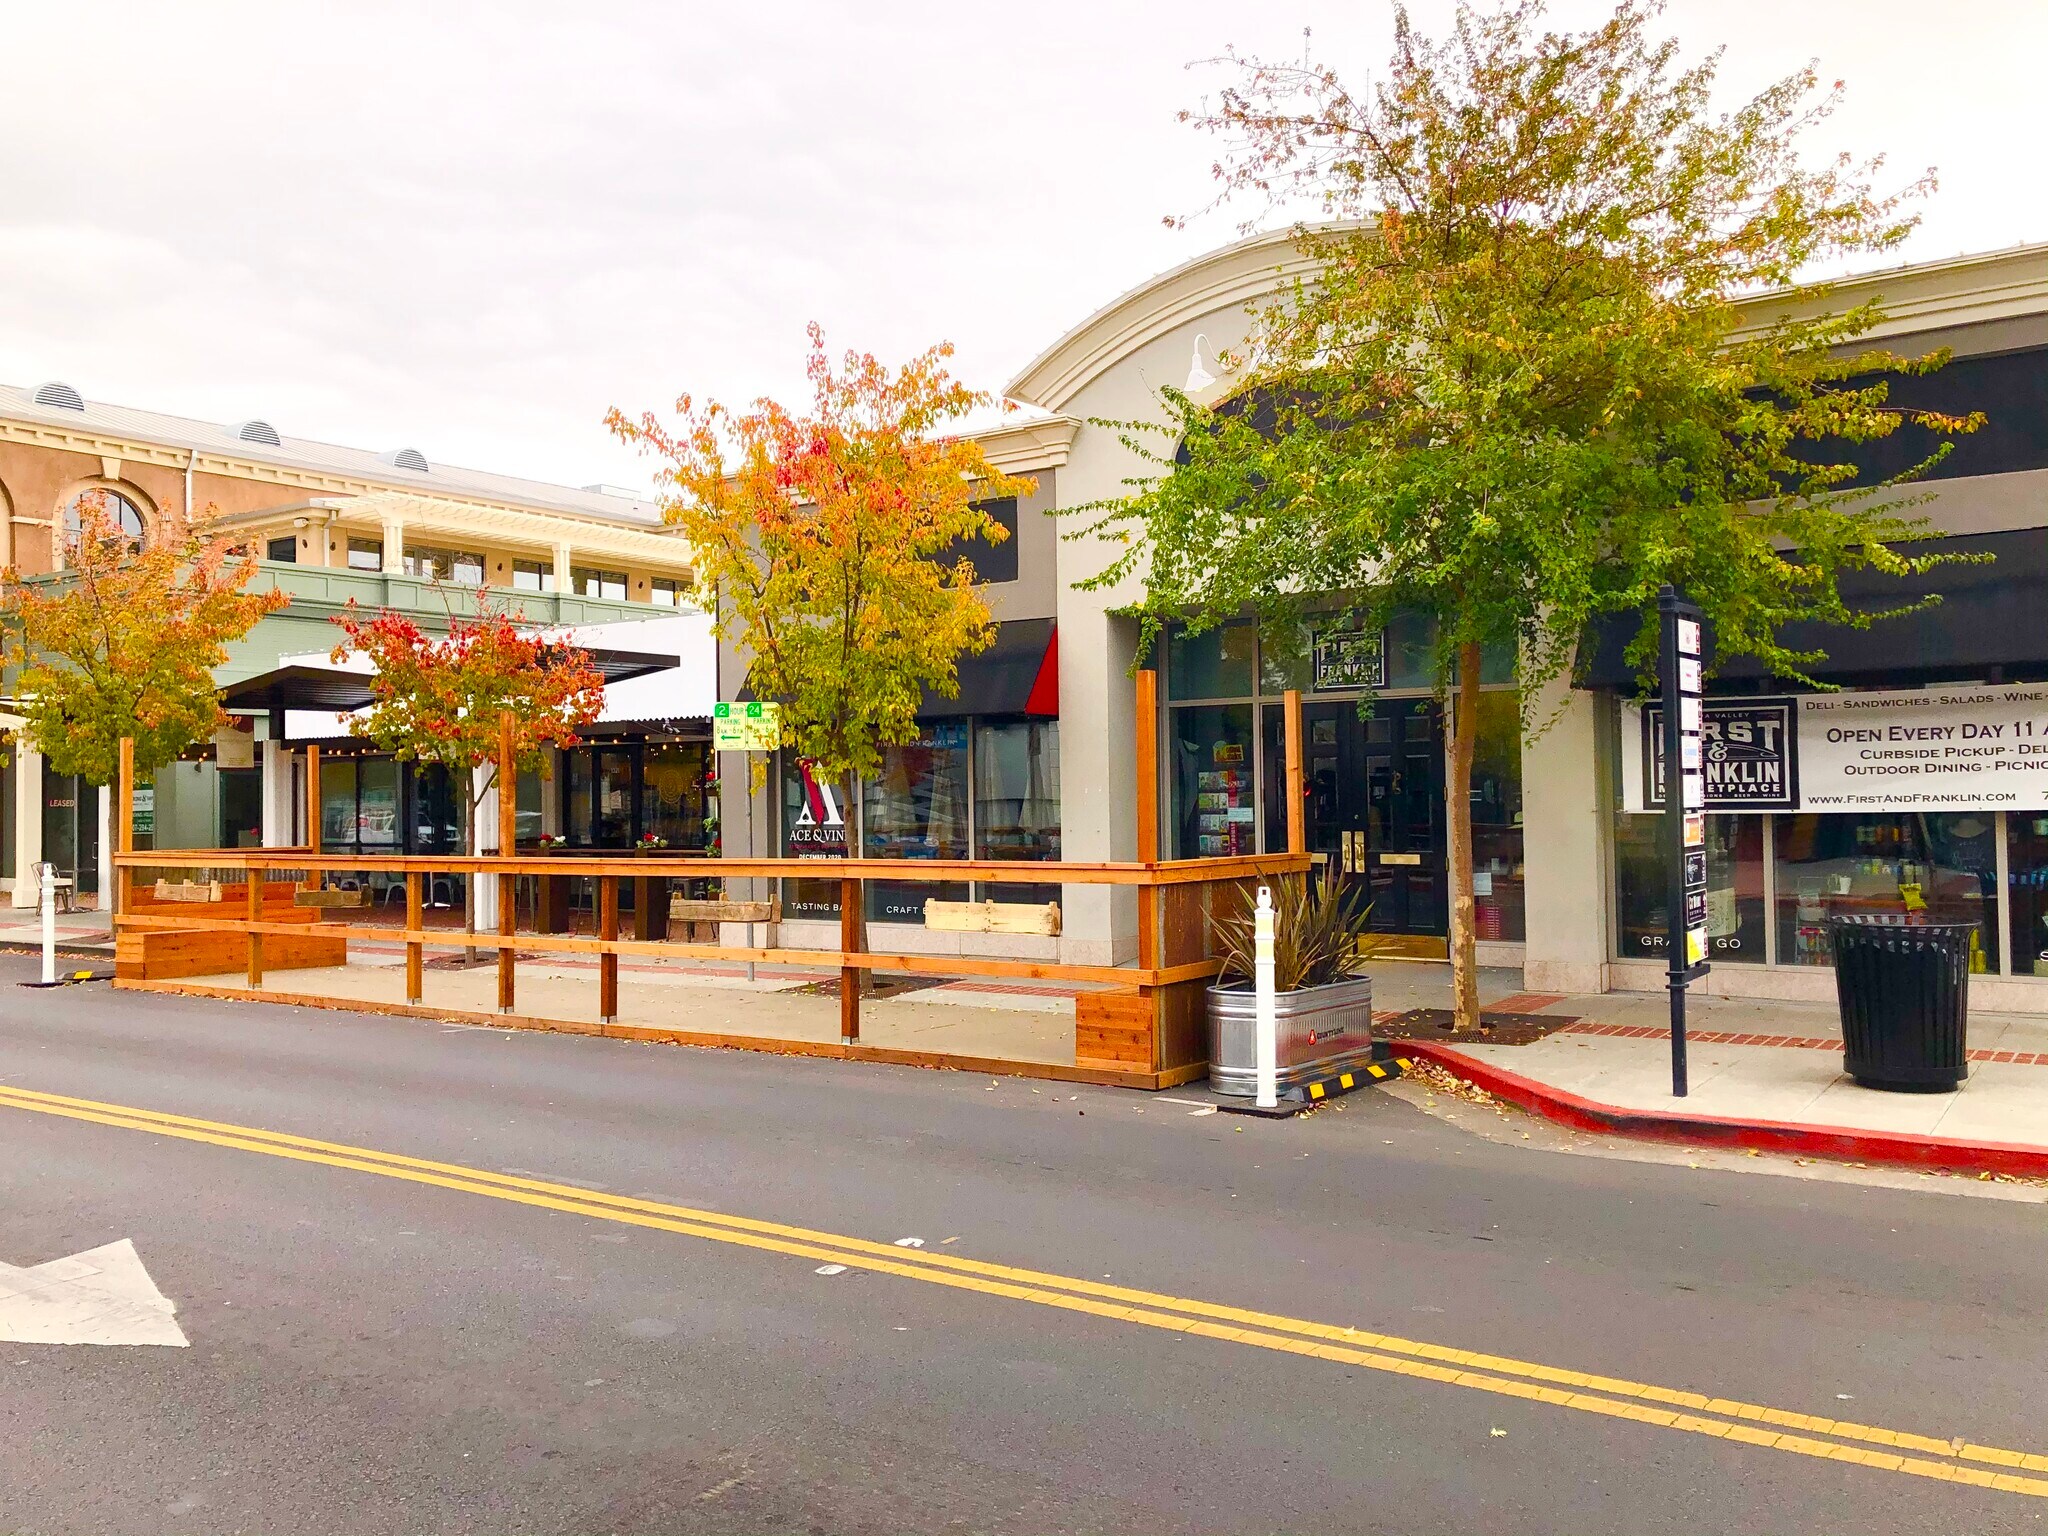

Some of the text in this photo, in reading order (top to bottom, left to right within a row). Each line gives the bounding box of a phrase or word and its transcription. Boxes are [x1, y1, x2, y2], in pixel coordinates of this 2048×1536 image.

[1806, 701, 1834, 710] DELI
[1843, 697, 1930, 709] SANDWICHES
[1940, 695, 1994, 705] SALADS
[2004, 692, 2043, 701] WINE
[718, 705, 726, 716] 2
[749, 705, 760, 715] 24
[1827, 728, 1882, 743] OPEN
[1889, 725, 1956, 741] EVERY
[1962, 723, 2005, 739] DAY
[2013, 721, 2032, 737] 11
[1708, 741, 1728, 761] &
[1860, 749, 1940, 759] CURBSIDE
[1945, 747, 2006, 757] PICKUP
[1844, 764, 1920, 775] OUTDOOR
[1925, 763, 1982, 773] DINING
[1659, 784, 1780, 793] METPLACE
[50, 799, 75, 807] LEASED
[789, 828, 847, 843] ACE & VIN
[791, 902, 829, 911] TASTING
[886, 906, 918, 914] CRAFT
[1641, 935, 1741, 949] GR GO
